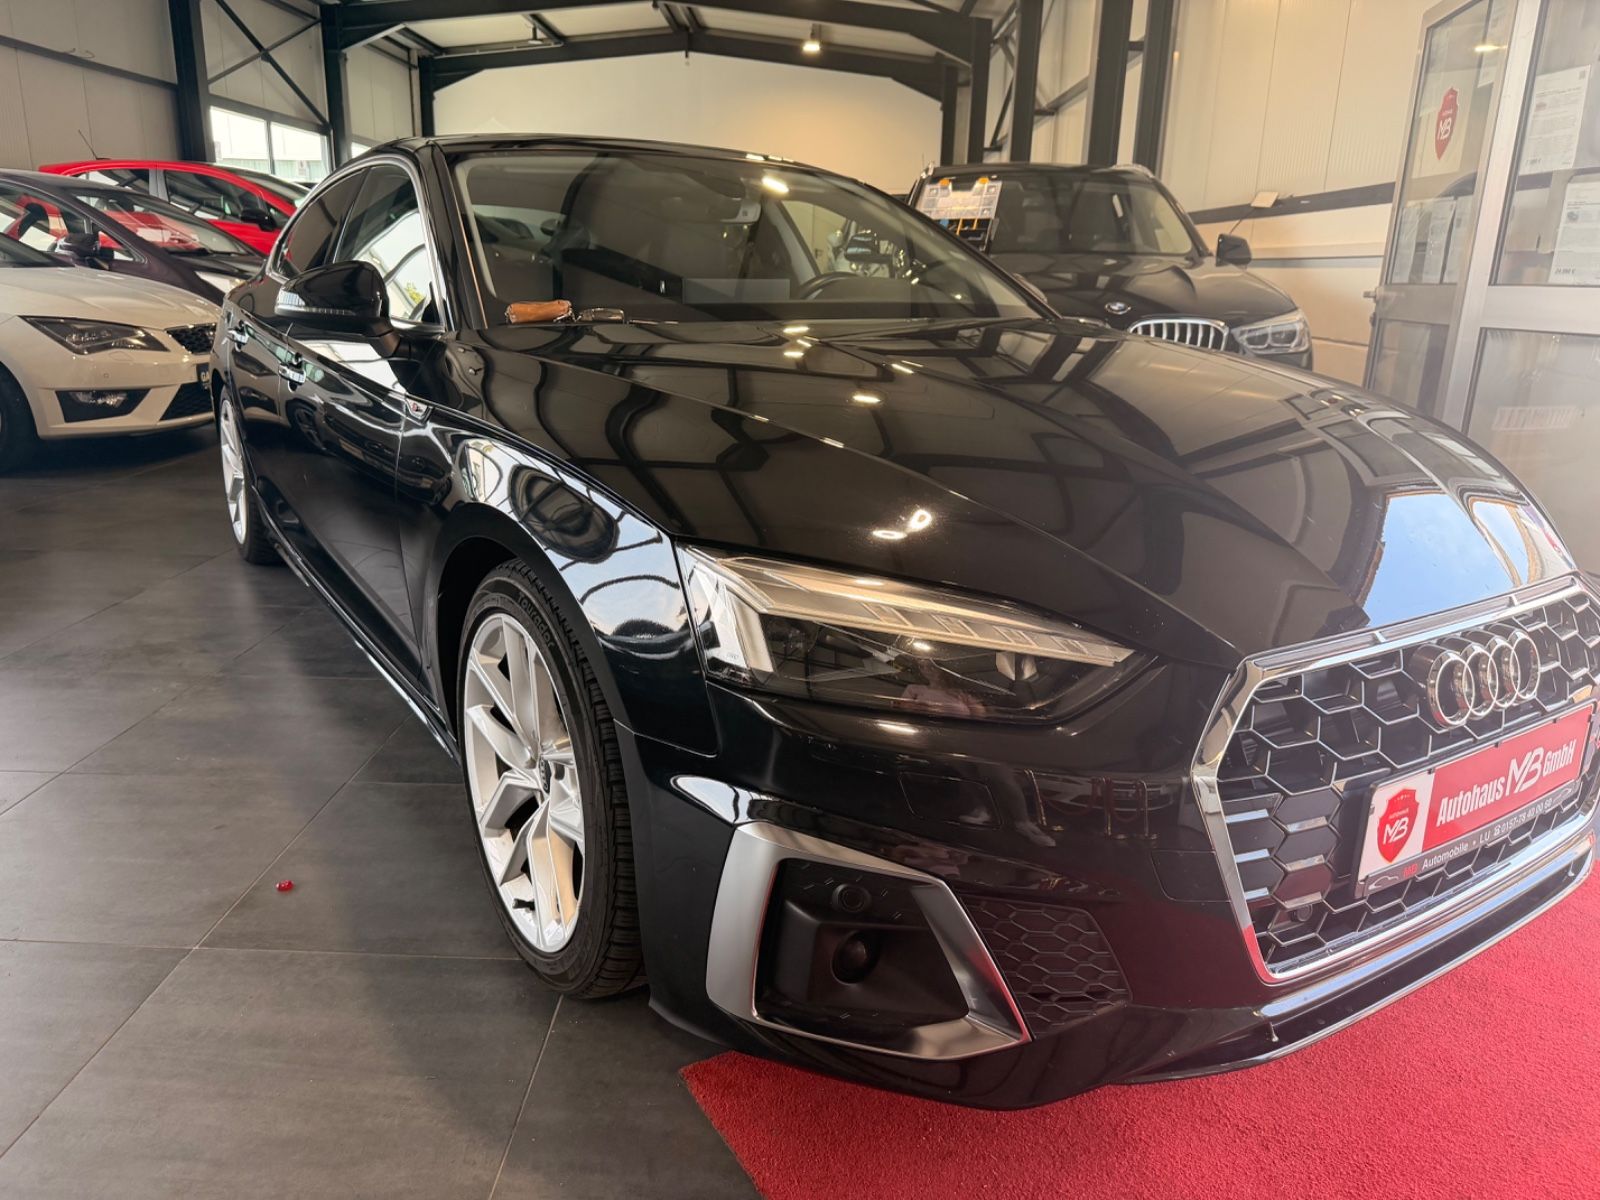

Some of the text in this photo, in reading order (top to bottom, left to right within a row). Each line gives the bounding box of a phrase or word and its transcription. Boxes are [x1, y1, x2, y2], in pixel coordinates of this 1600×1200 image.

[1436, 739, 1577, 828] Autohaus MB GmbH
[1383, 816, 1409, 845] MB
[1421, 841, 1469, 871] Automobile
